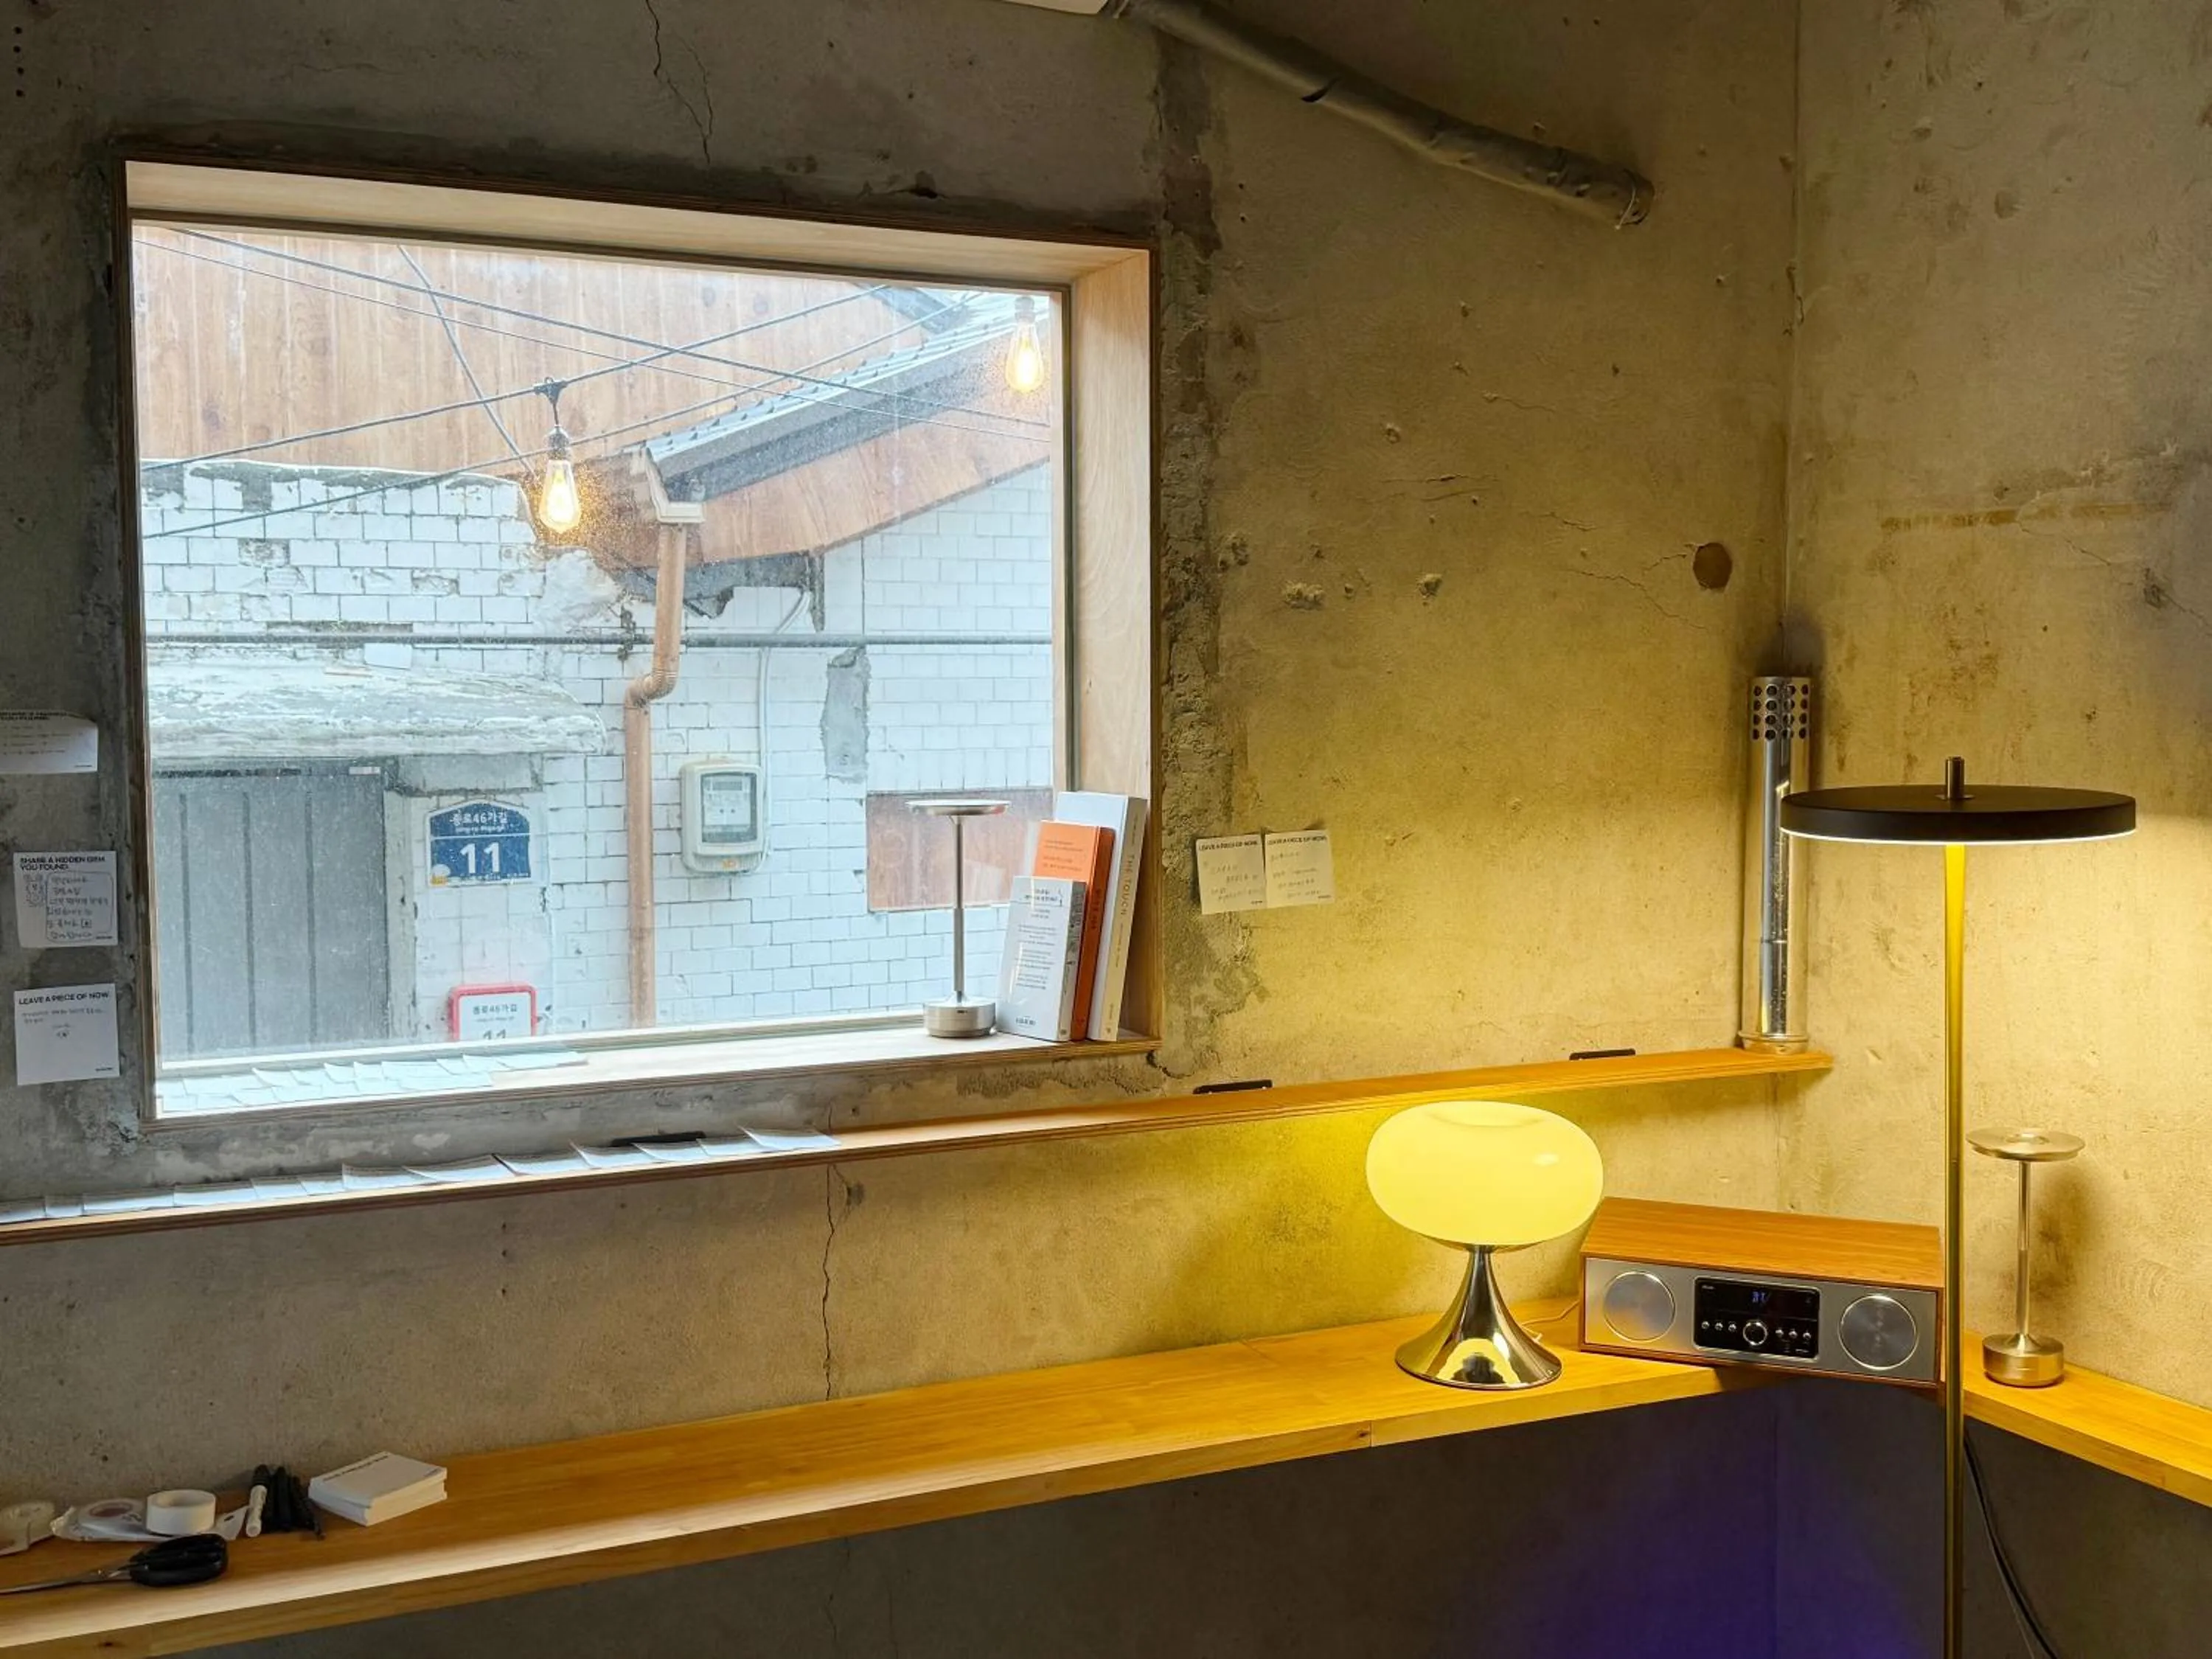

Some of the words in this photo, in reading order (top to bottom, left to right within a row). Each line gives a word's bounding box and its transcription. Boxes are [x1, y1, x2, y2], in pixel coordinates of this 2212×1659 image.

[460, 842, 500, 874] 11
[1124, 855, 1135, 874] THE
[1120, 877, 1132, 916] TOUCH
[18, 995, 44, 1005] LEAVE
[52, 994, 75, 1002] PIECE
[77, 992, 88, 1001] OF
